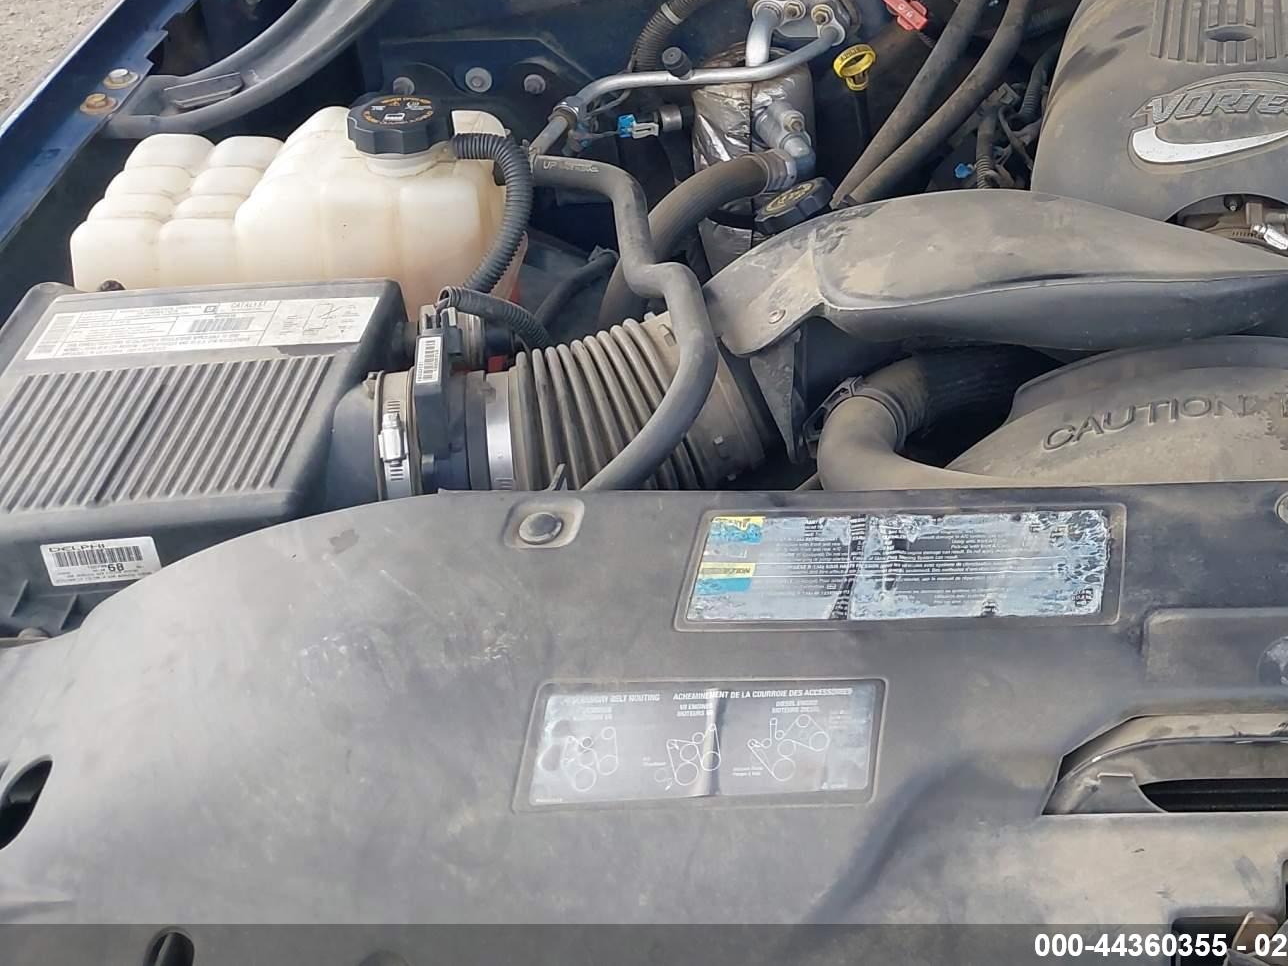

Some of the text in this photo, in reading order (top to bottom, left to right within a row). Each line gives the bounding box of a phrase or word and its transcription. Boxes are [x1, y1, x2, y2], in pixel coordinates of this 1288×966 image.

[1041, 395, 1256, 452] CAUTION
[48, 543, 107, 554] DELPHI
[730, 690, 741, 699] DE
[741, 690, 751, 699] LA
